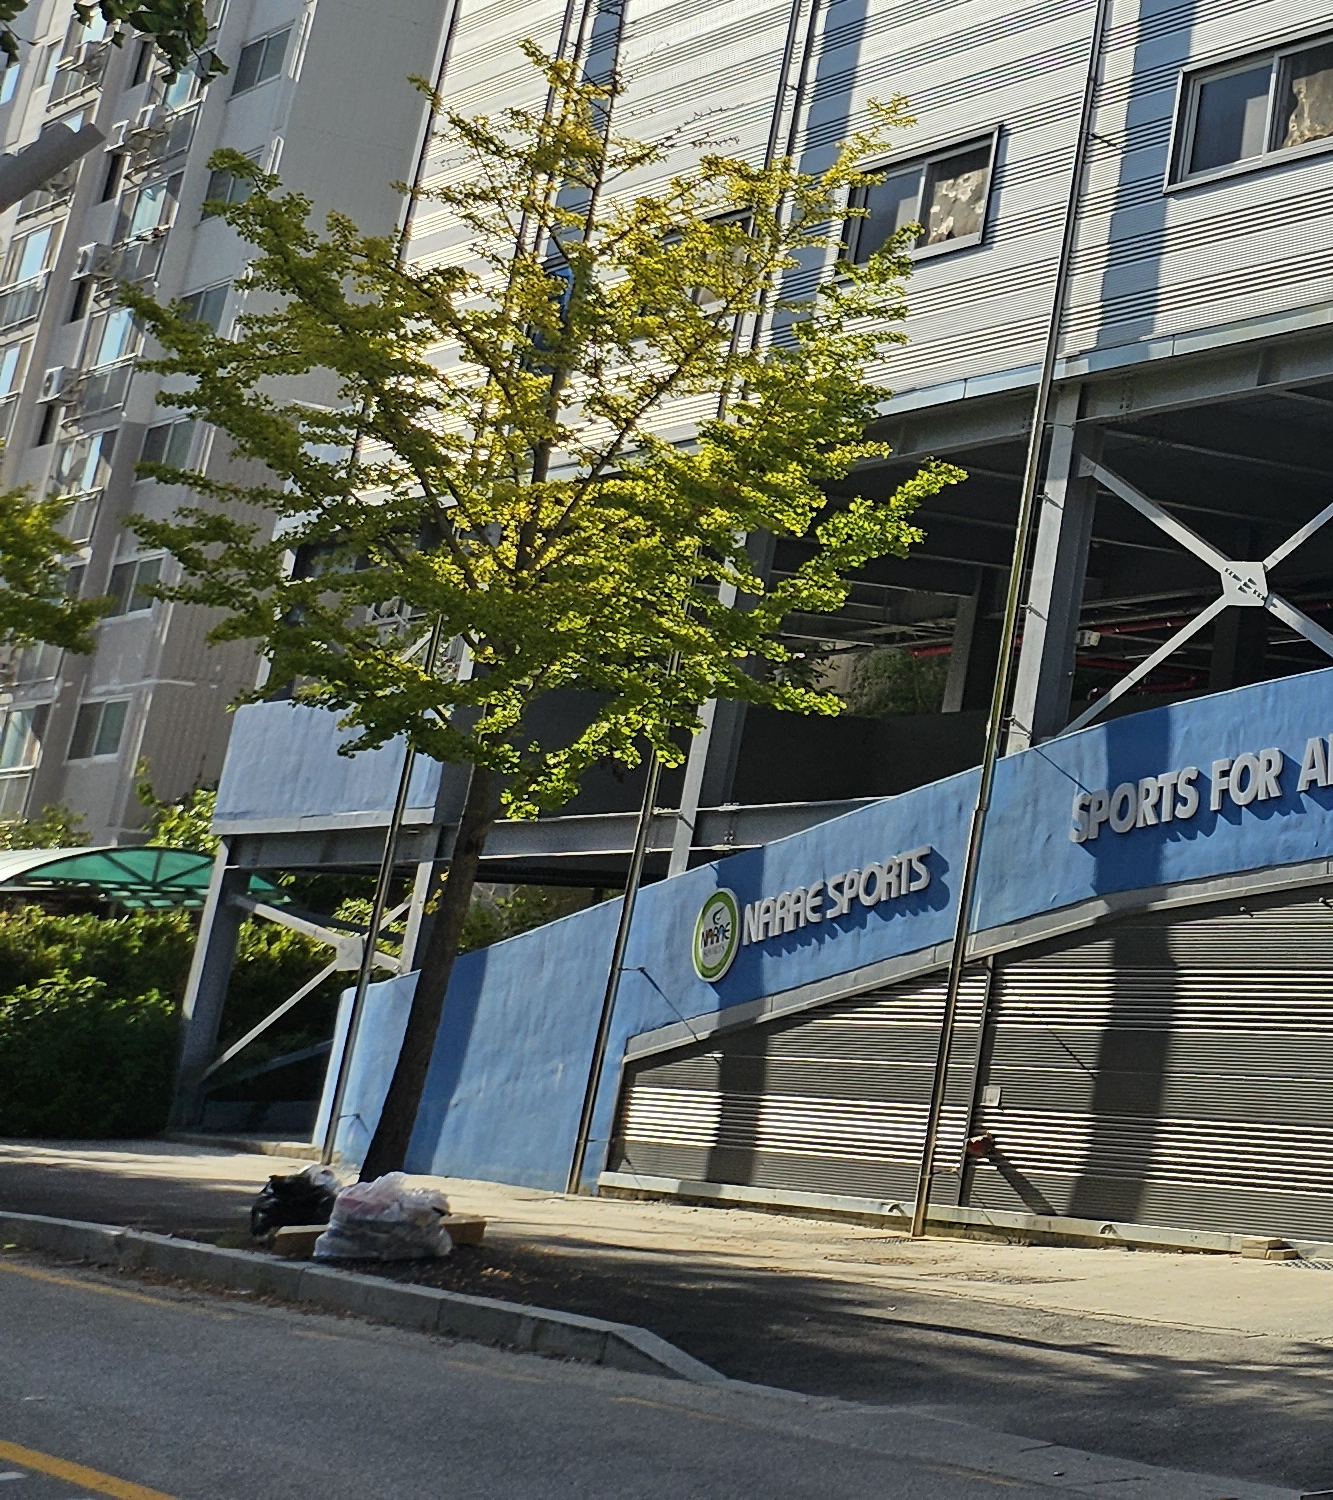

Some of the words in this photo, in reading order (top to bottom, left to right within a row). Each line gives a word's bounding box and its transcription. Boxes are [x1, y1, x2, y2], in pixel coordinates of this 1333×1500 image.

[1069, 766, 1200, 844] SPORTS
[1209, 747, 1283, 812] FOR
[742, 880, 825, 946] NARAE
[826, 845, 932, 919] SPORTS
